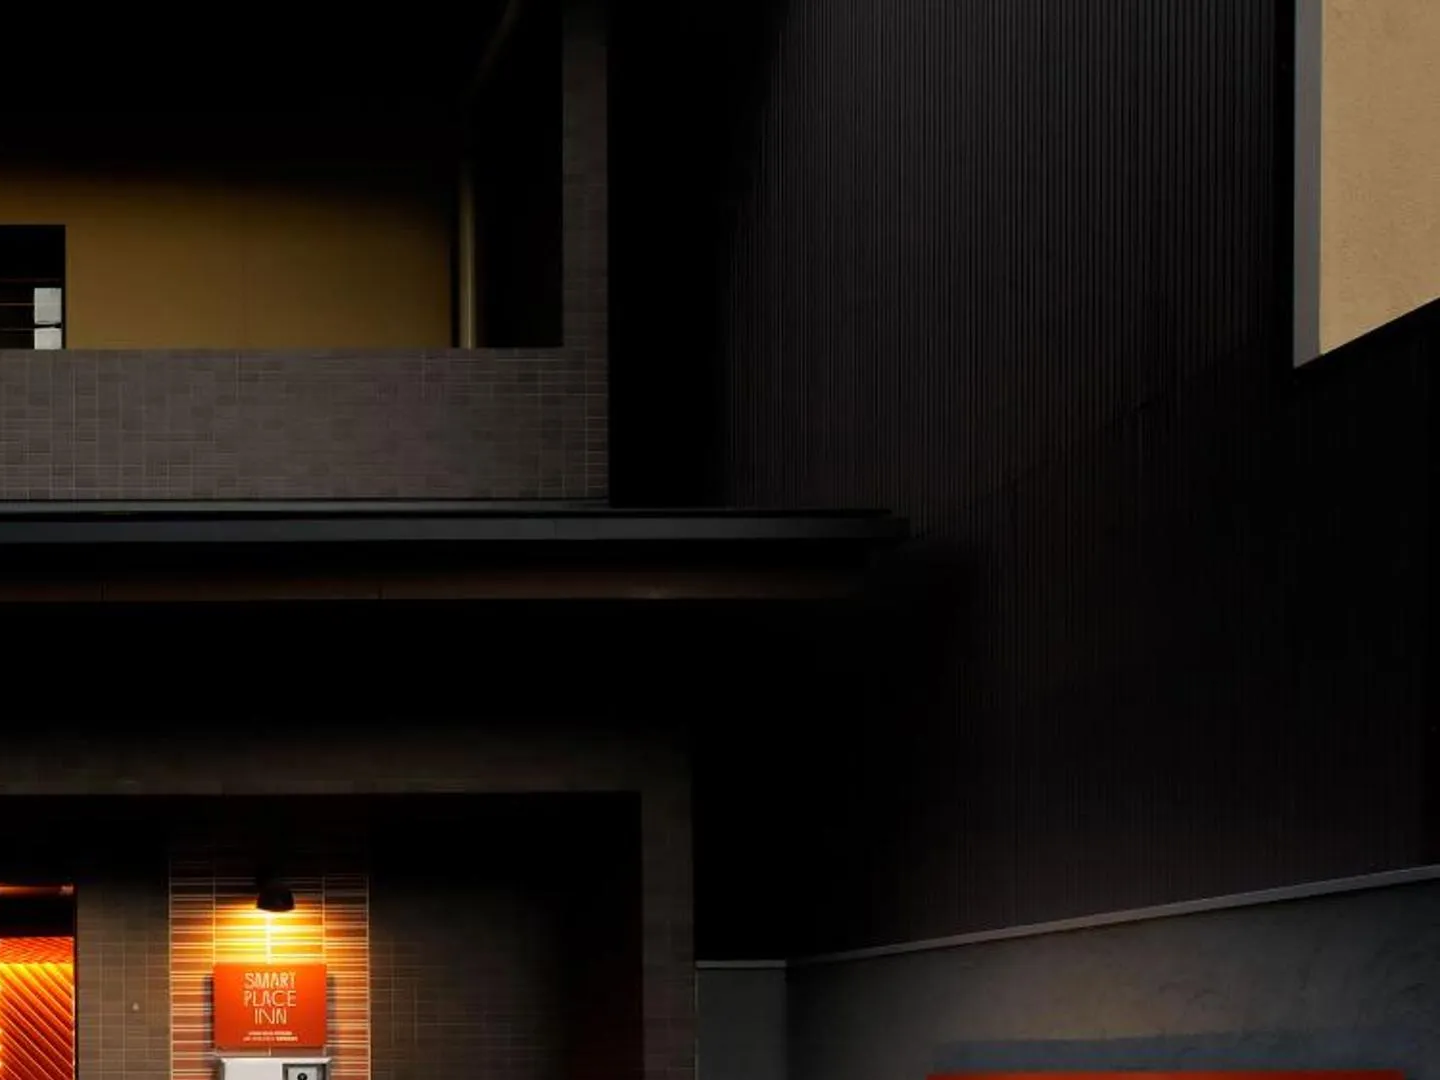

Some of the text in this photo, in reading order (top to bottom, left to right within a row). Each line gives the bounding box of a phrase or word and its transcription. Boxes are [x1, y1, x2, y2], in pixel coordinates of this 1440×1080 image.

[245, 973, 296, 989] SMART
[244, 991, 297, 1007] PLACE
[255, 1008, 288, 1025] INN
